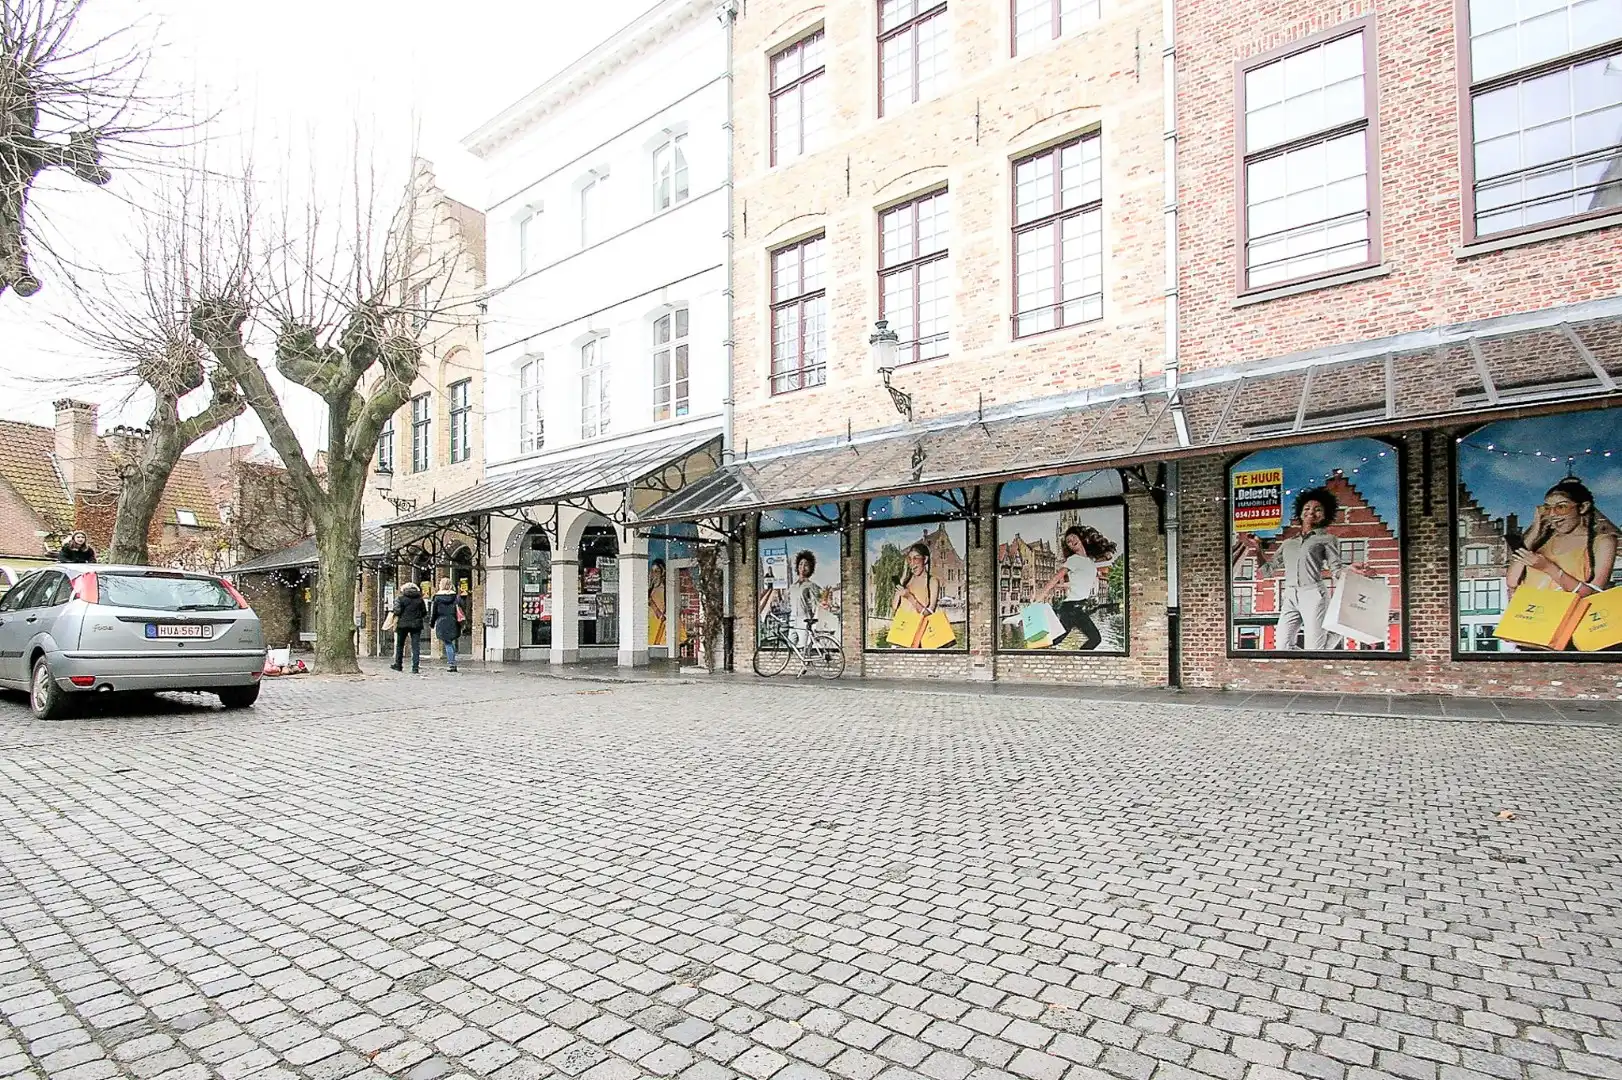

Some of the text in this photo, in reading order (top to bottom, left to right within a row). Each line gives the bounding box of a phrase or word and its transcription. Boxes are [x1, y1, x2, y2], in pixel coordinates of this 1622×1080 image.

[1235, 471, 1280, 486] TE HUUR
[1261, 509, 1270, 517] 62
[1271, 508, 1280, 516] 52
[203, 626, 211, 636] B
